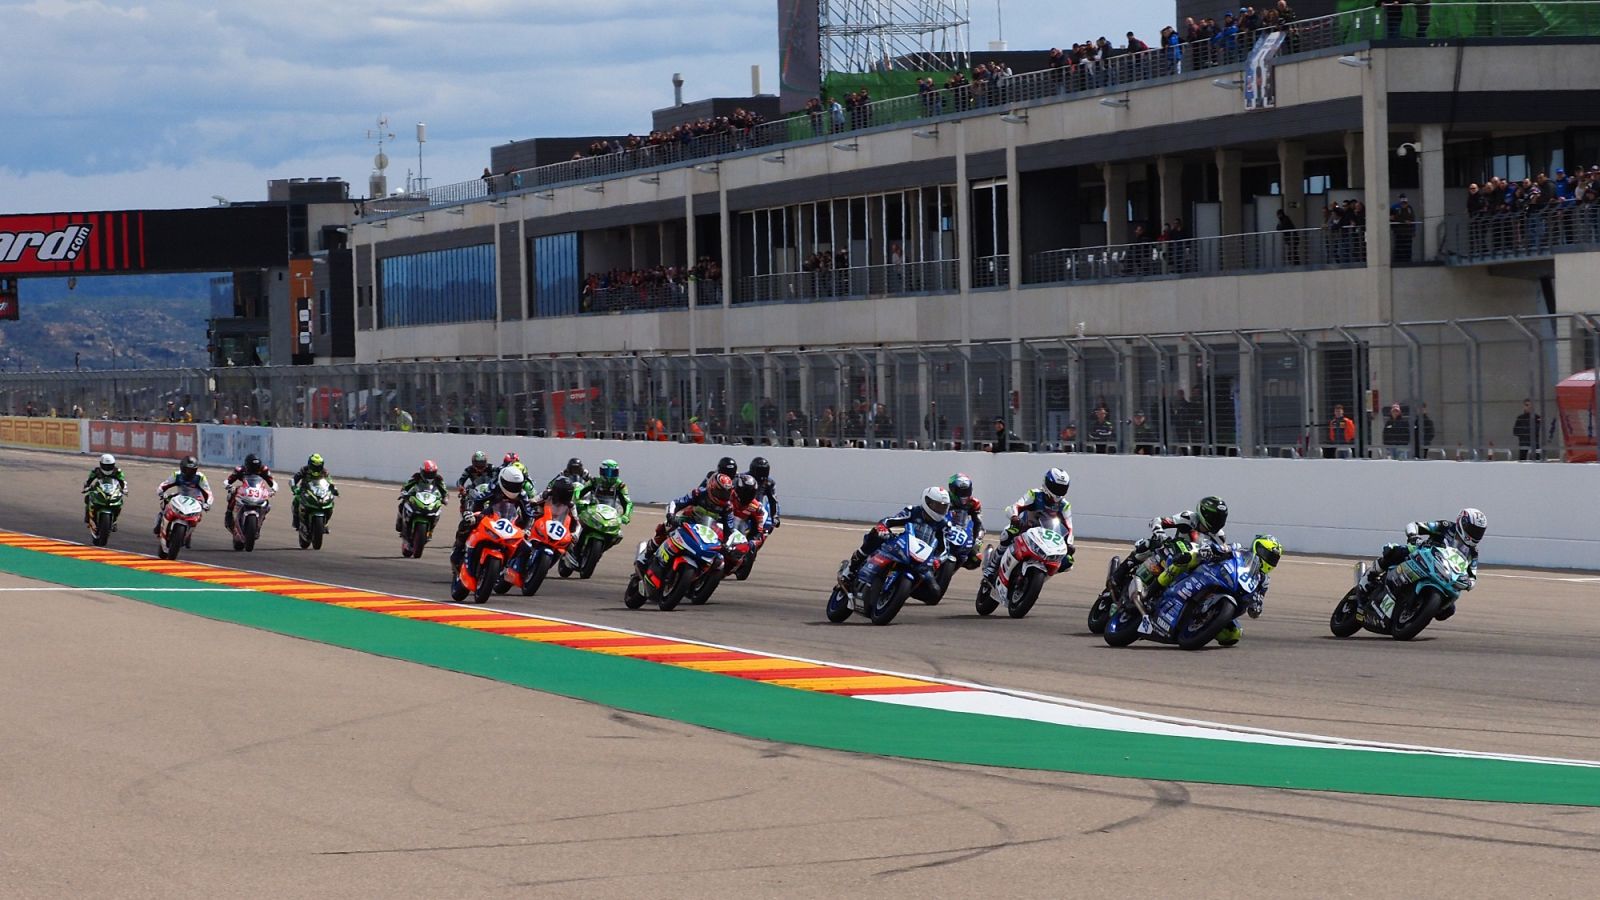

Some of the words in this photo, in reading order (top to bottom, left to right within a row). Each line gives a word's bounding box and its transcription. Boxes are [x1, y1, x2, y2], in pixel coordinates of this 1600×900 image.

[494, 520, 514, 534] 30
[549, 523, 565, 538] 19
[1043, 529, 1062, 546] 52
[915, 543, 926, 554] 7
